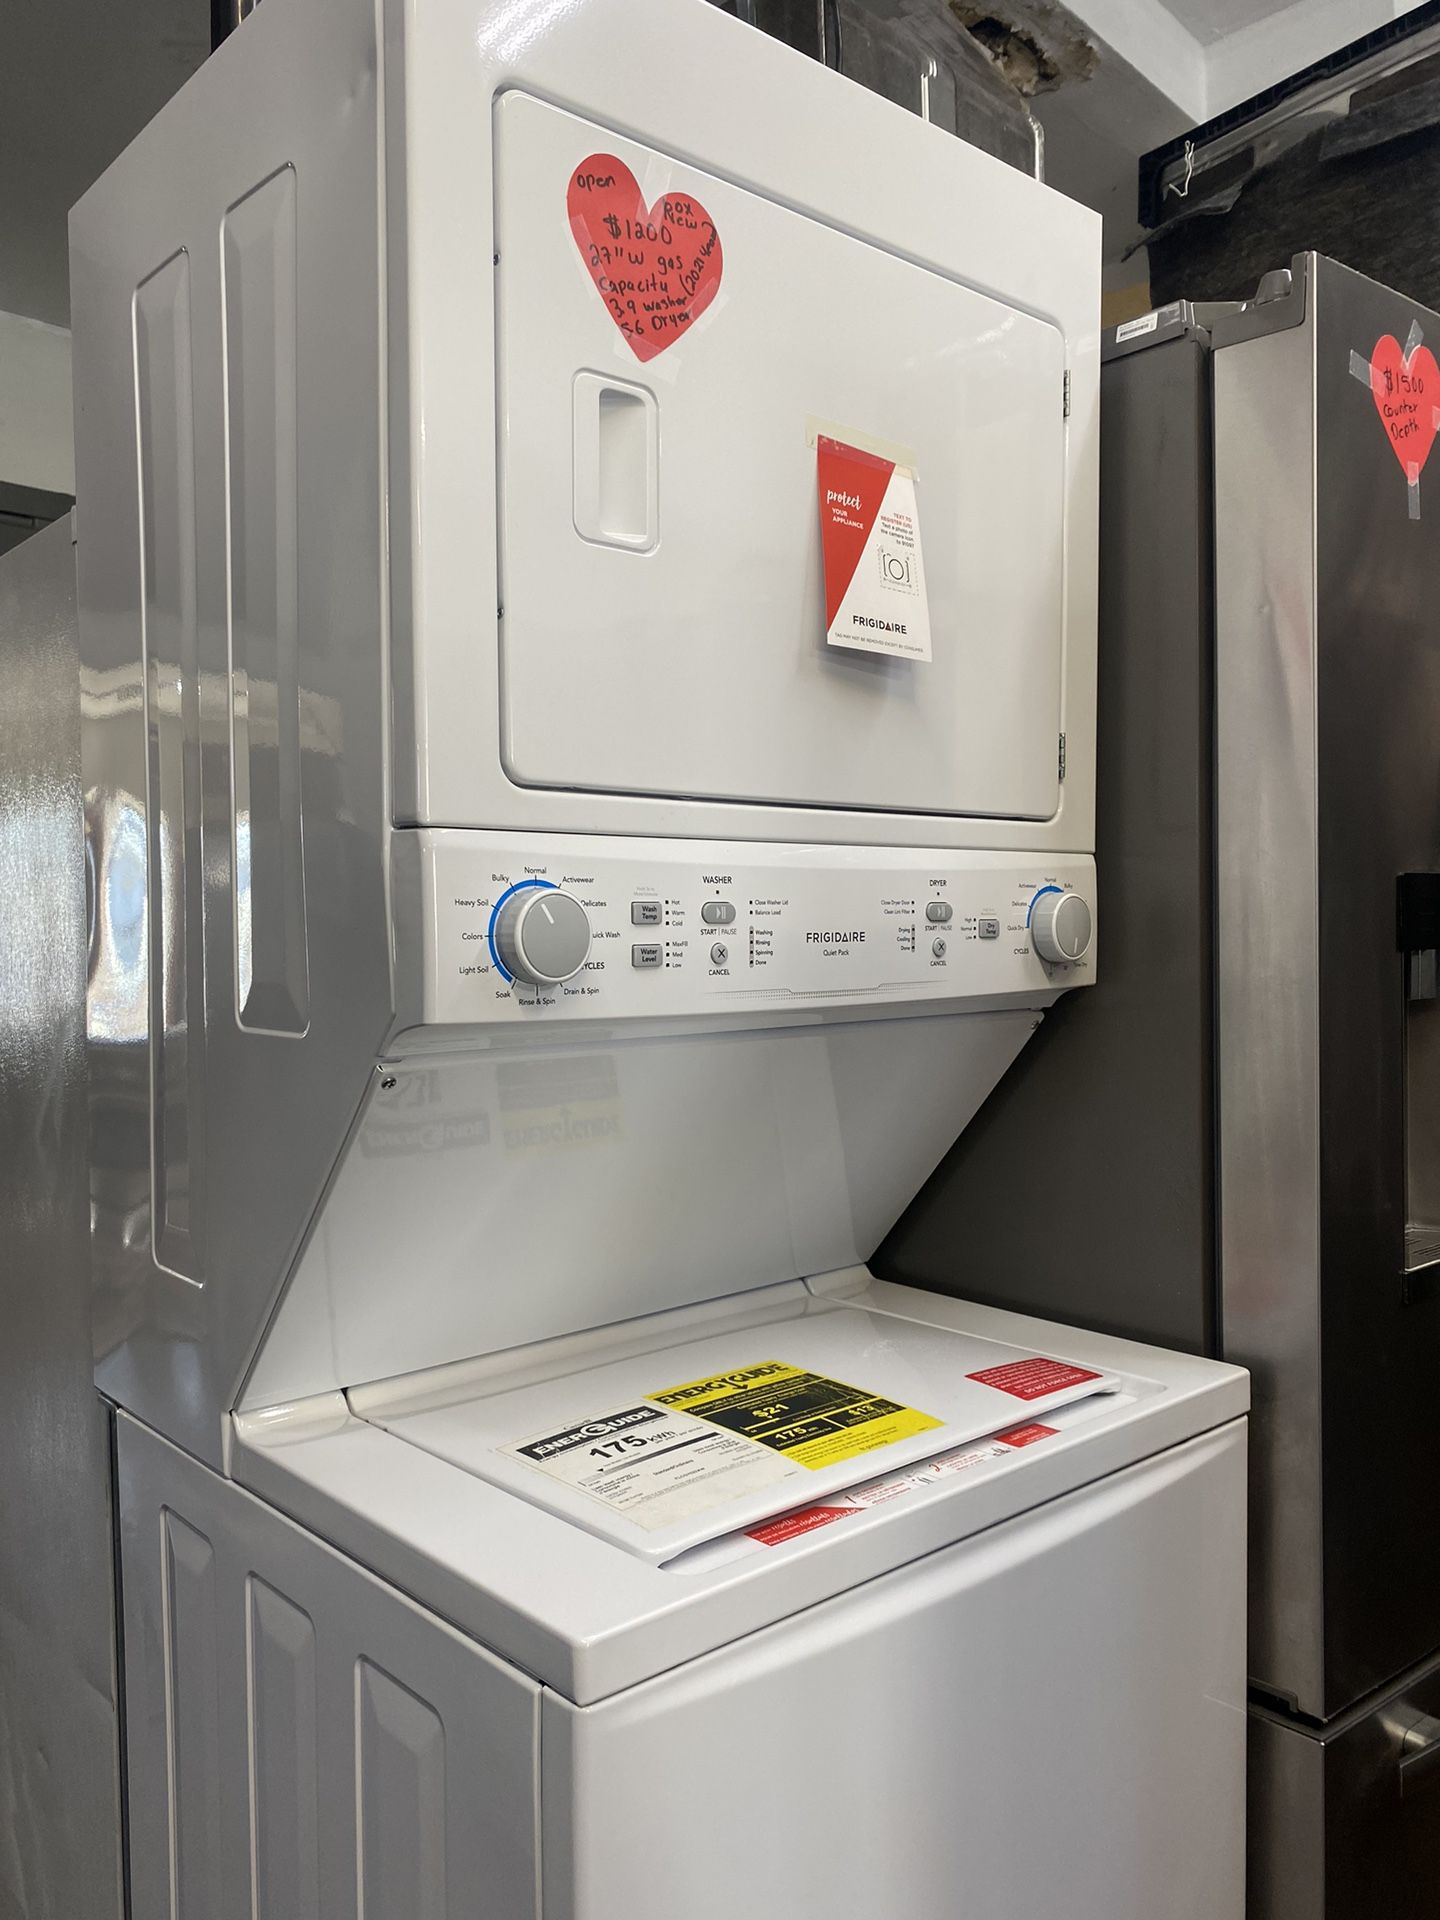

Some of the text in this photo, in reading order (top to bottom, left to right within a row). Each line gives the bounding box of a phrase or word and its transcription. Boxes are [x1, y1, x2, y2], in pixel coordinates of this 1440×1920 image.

[576, 174, 616, 192] open
[603, 213, 672, 245] $1200
[658, 255, 683, 275] gas
[1383, 366, 1424, 397] $1500
[1391, 418, 1419, 441] Depth
[827, 489, 862, 510] protect
[832, 507, 848, 517] YOUR
[832, 515, 864, 530] APPLIANCE
[853, 615, 907, 635] FRIGIDAIRE
[524, 867, 547, 875] Normal
[491, 874, 510, 883] Bulky
[702, 876, 732, 884] WASHER
[455, 899, 476, 907] Heavy
[806, 932, 866, 943] FRIGIDAIRE
[459, 967, 475, 975] Light
[581, 962, 605, 970] YCLES
[586, 987, 600, 996] Spin
[536, 998, 541, 1006] &
[542, 998, 556, 1006] Spin
[752, 1404, 789, 1418] $21
[532, 1409, 656, 1455] ENERGUIDE
[775, 1427, 807, 1440] 175
[589, 1431, 675, 1459] 175 kWh
